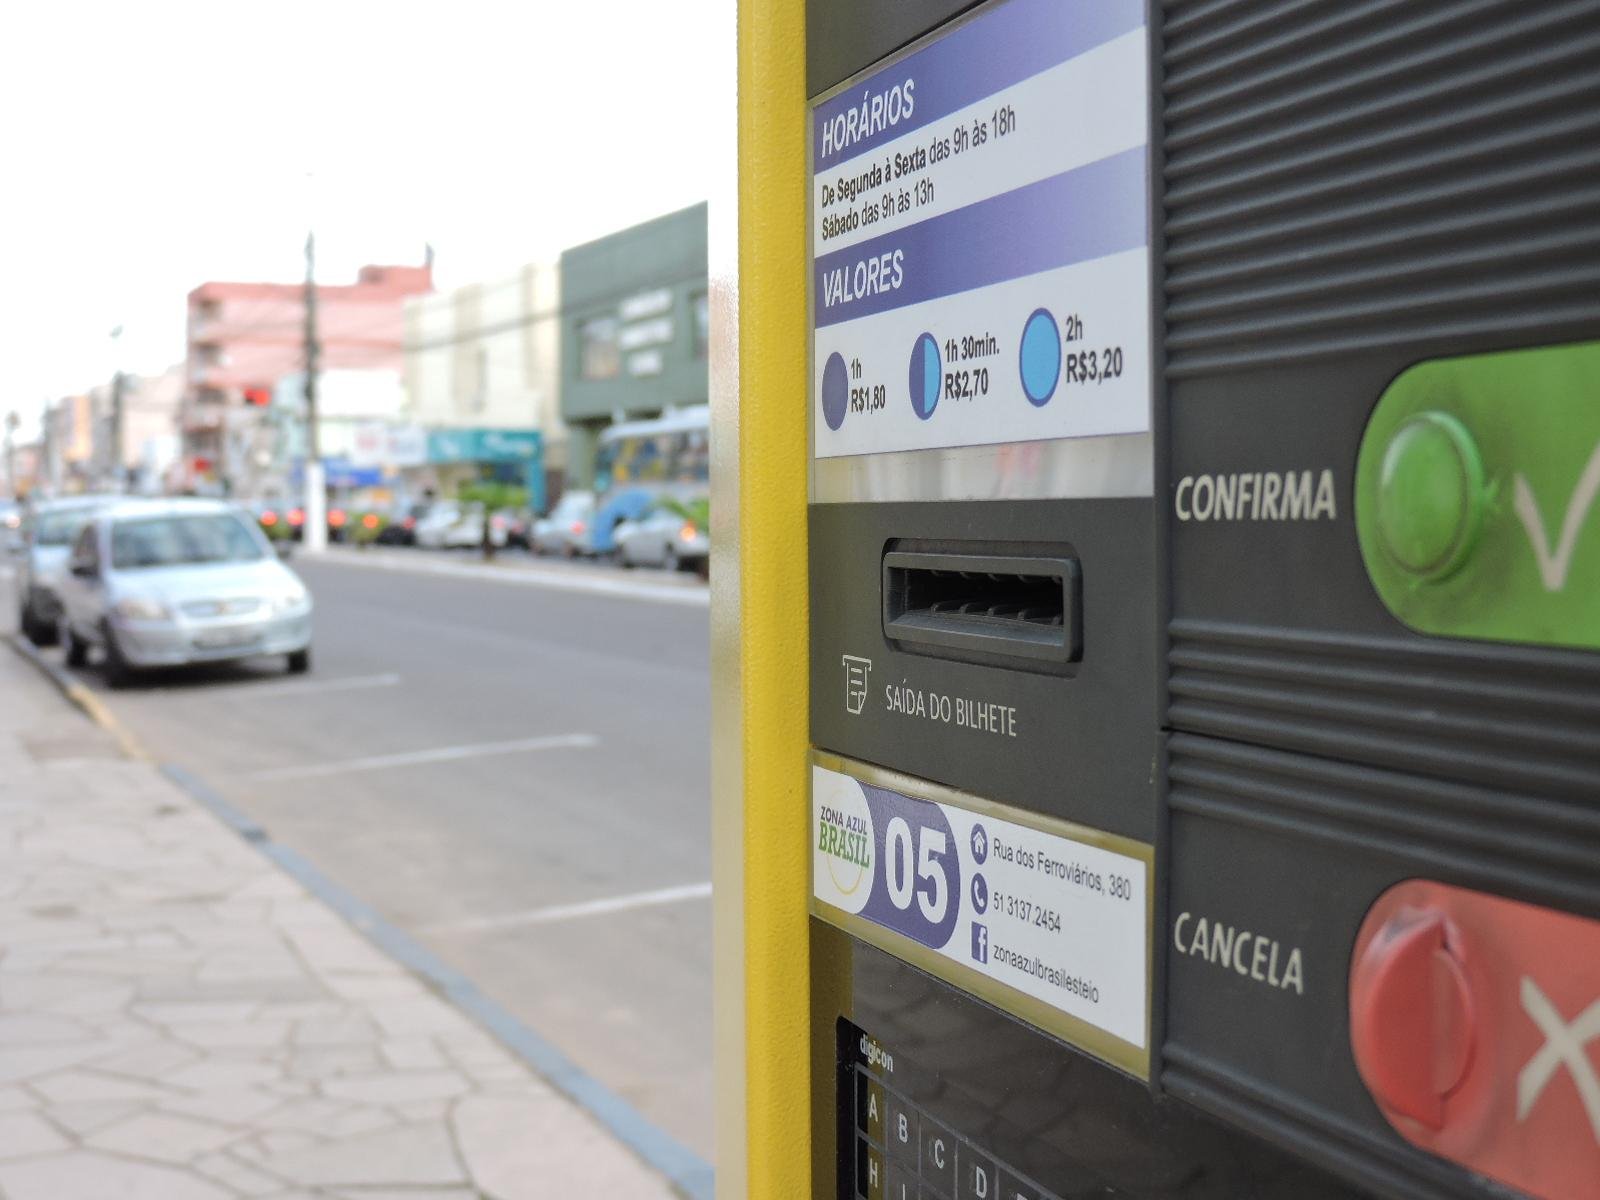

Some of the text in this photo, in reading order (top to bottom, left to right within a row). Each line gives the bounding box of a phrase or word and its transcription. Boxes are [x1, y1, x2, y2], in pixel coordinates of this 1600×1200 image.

[821, 78, 915, 158] HORÁRIOS
[822, 104, 1016, 208] De Segunda à Sexta das 9h às 18h
[822, 177, 934, 241] Sábado das 9h às 13h
[823, 249, 904, 307] VALORES
[944, 332, 1000, 363] 1h 30min.
[1066, 315, 1082, 342] 2h
[851, 358, 862, 380] 1h
[944, 368, 988, 402] R$2,70
[1066, 347, 1123, 386] R$3,20
[851, 384, 886, 415] R$1,80
[1175, 468, 1336, 521] CONFIRMA
[885, 678, 1017, 737] SAÍDA DO BILHETE
[818, 821, 870, 869] BRASIL
[820, 806, 868, 836] ZONA AZUL
[885, 816, 948, 924] 05
[993, 837, 1131, 901] Rua dos Ferroviários, 380
[993, 892, 1061, 934] 51 3137.2454
[993, 944, 1099, 1004] zonaazulbrasilesteio
[1173, 911, 1304, 996] CANCELA
[859, 1034, 894, 1073] digicon
[868, 1093, 987, 1198] A B C D
[869, 1158, 879, 1188] H
